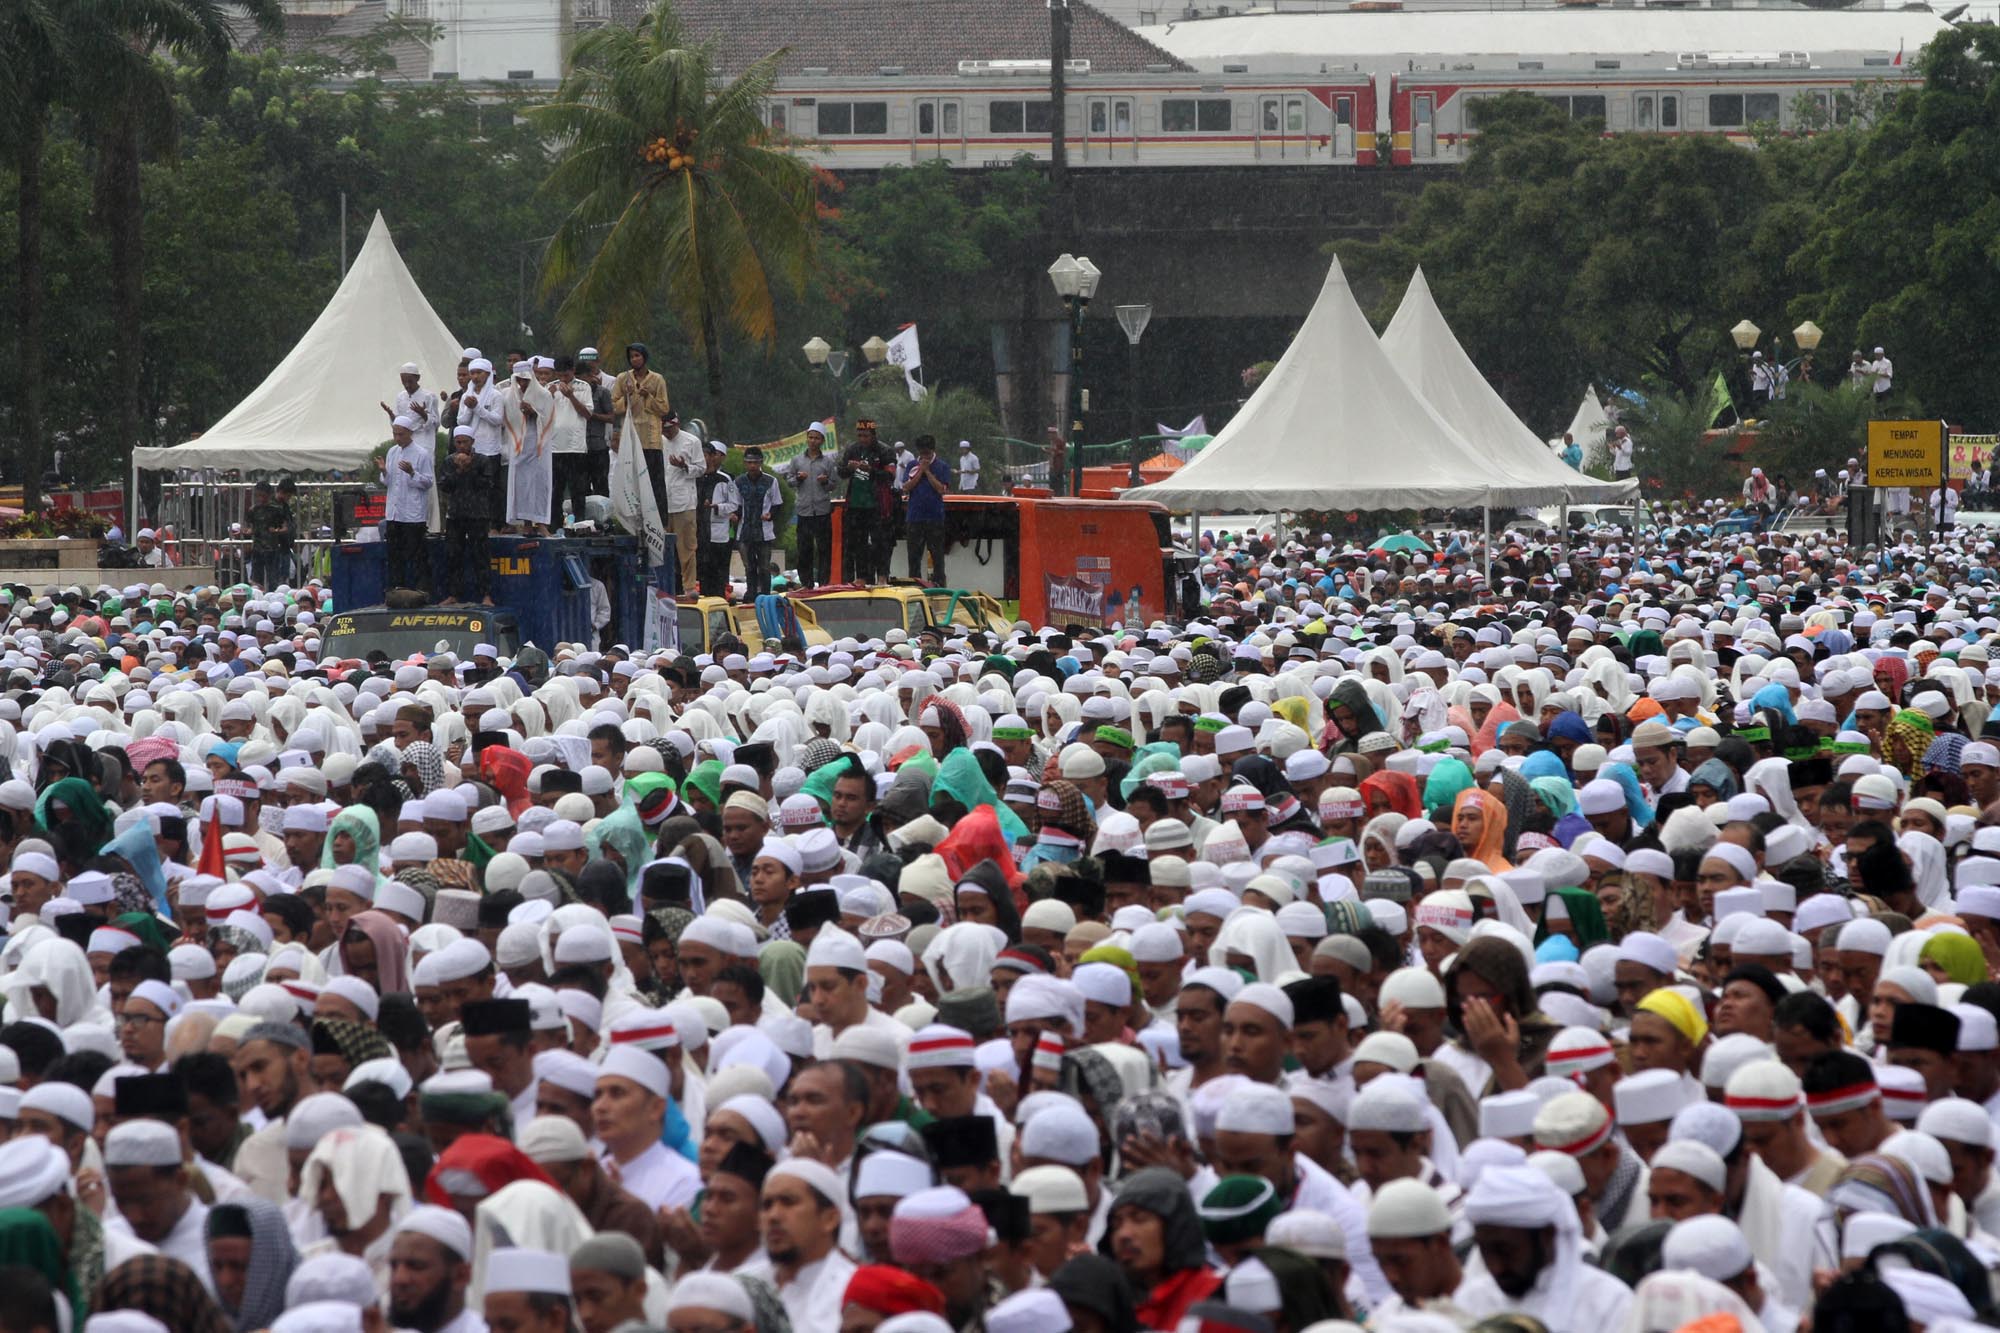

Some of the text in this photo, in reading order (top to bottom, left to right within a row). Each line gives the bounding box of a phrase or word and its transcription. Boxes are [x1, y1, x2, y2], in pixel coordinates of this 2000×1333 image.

[1890, 430, 1919, 440] TEMPAT
[1883, 449, 1926, 459] MENUNGGU
[1875, 467, 1933, 478] KERETA WISATA
[390, 615, 469, 628] ANFEMAT
[472, 621, 481, 632] 9
